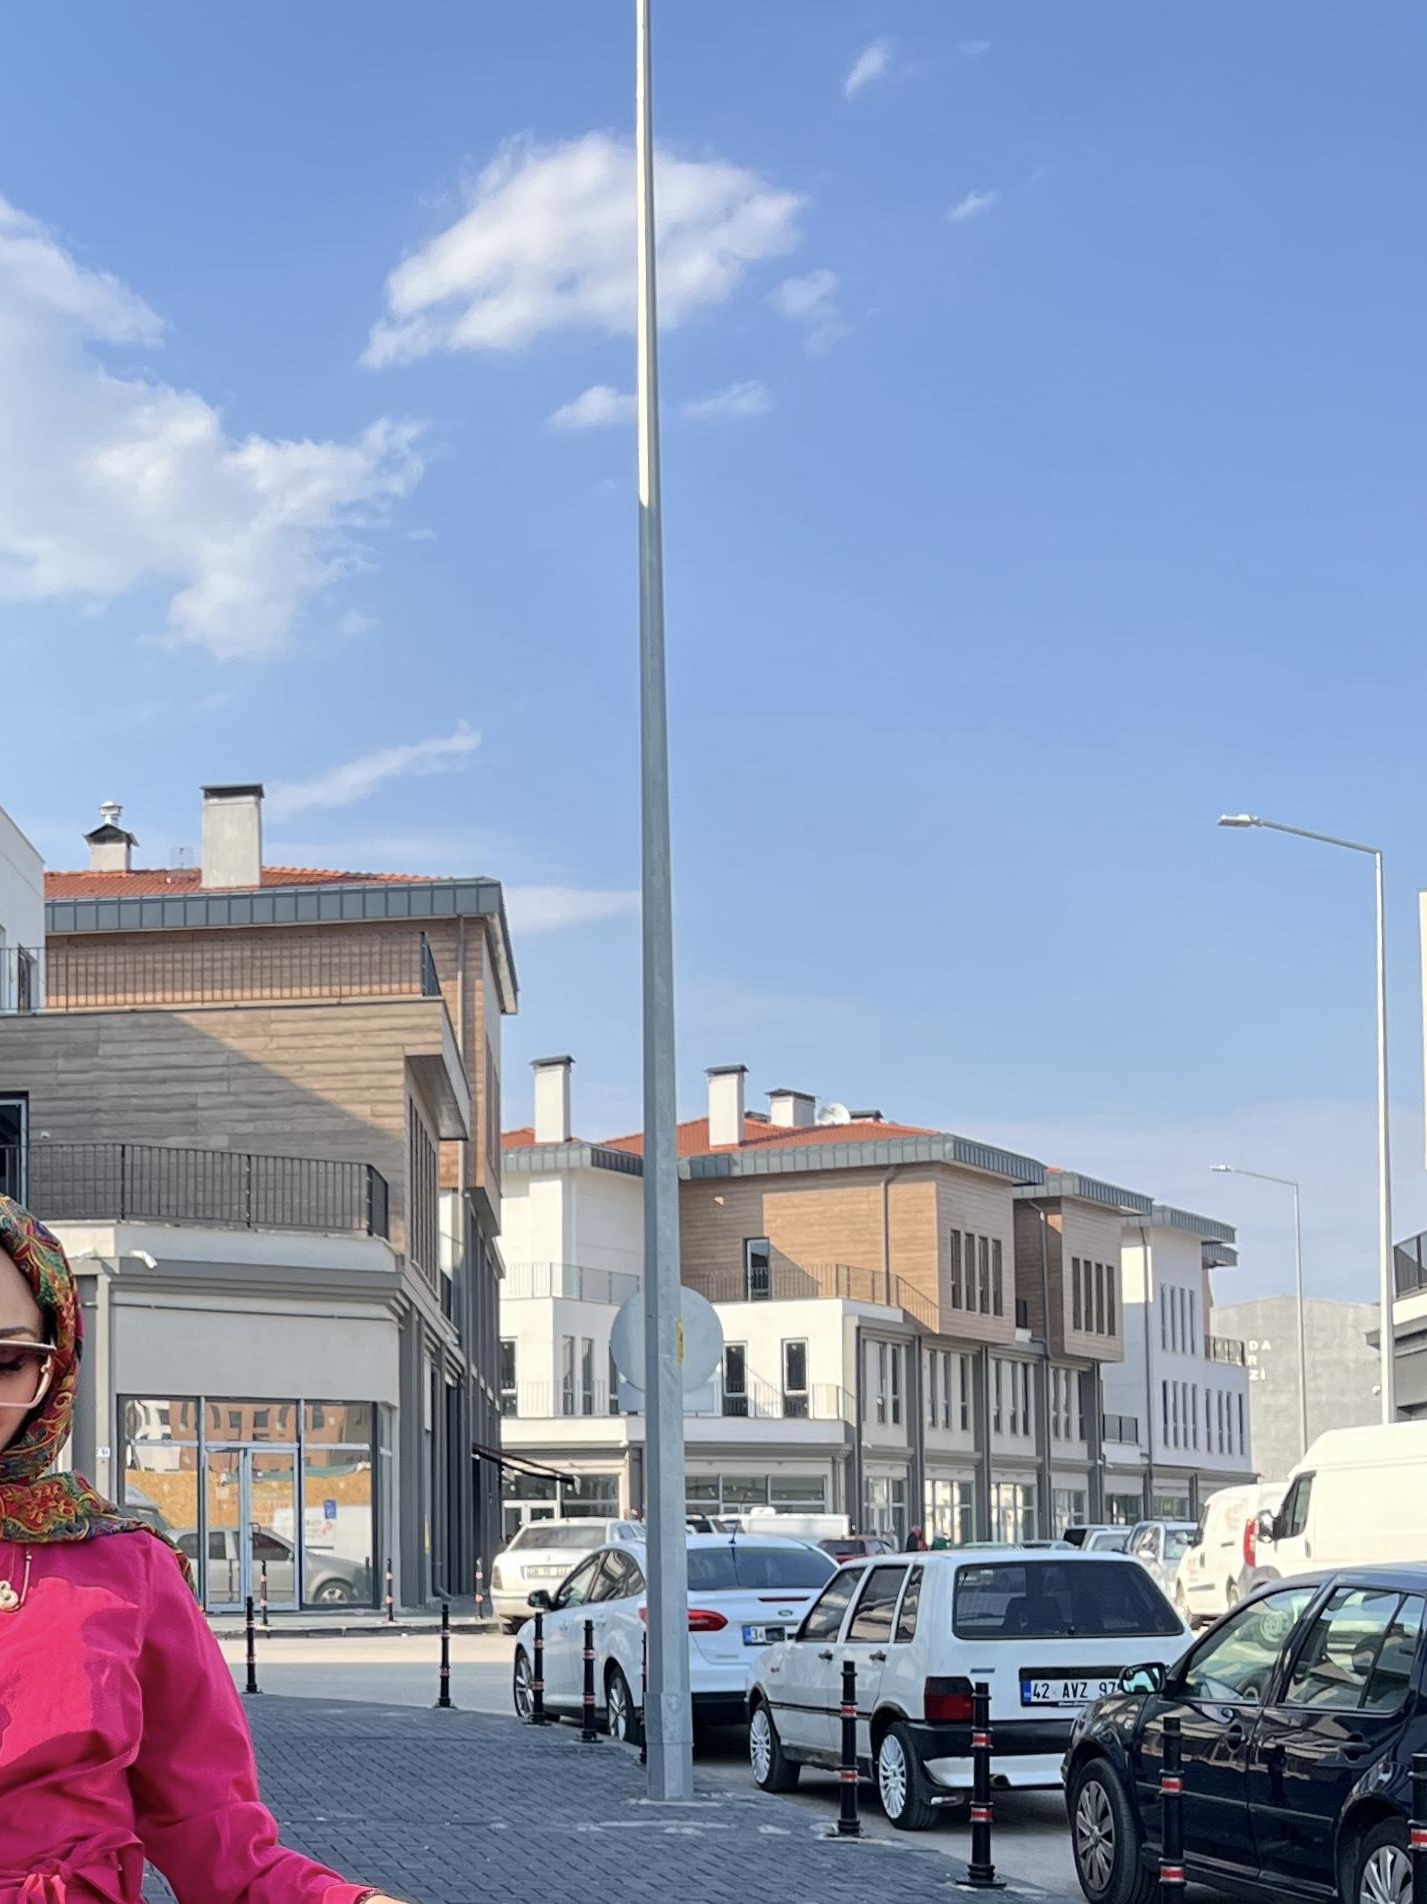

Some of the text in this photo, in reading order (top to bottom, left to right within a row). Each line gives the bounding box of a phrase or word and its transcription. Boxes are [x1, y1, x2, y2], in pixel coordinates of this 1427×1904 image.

[1033, 1681, 1121, 1699] 42 AVZ 97
